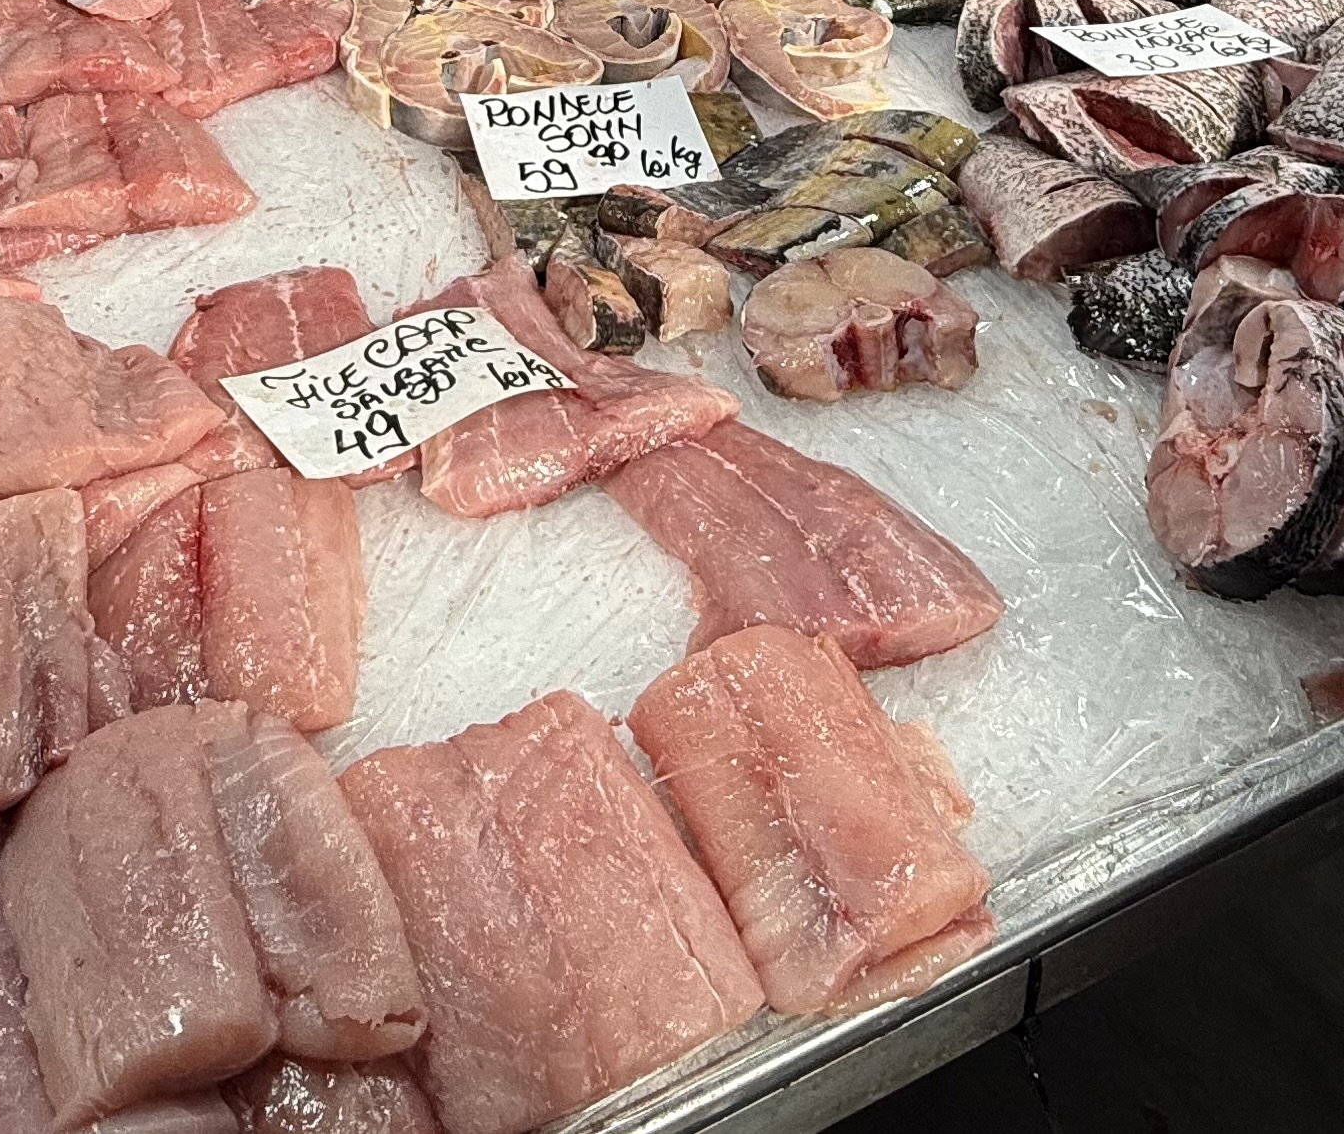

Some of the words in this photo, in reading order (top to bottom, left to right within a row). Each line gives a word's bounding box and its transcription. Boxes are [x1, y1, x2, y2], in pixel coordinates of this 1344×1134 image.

[1062, 17, 1202, 43] RONDELE
[478, 89, 636, 128] RONDELE
[538, 113, 642, 153] SOMN
[518, 158, 579, 193] 59
[363, 309, 477, 368] CRAP
[334, 408, 412, 459] 49
